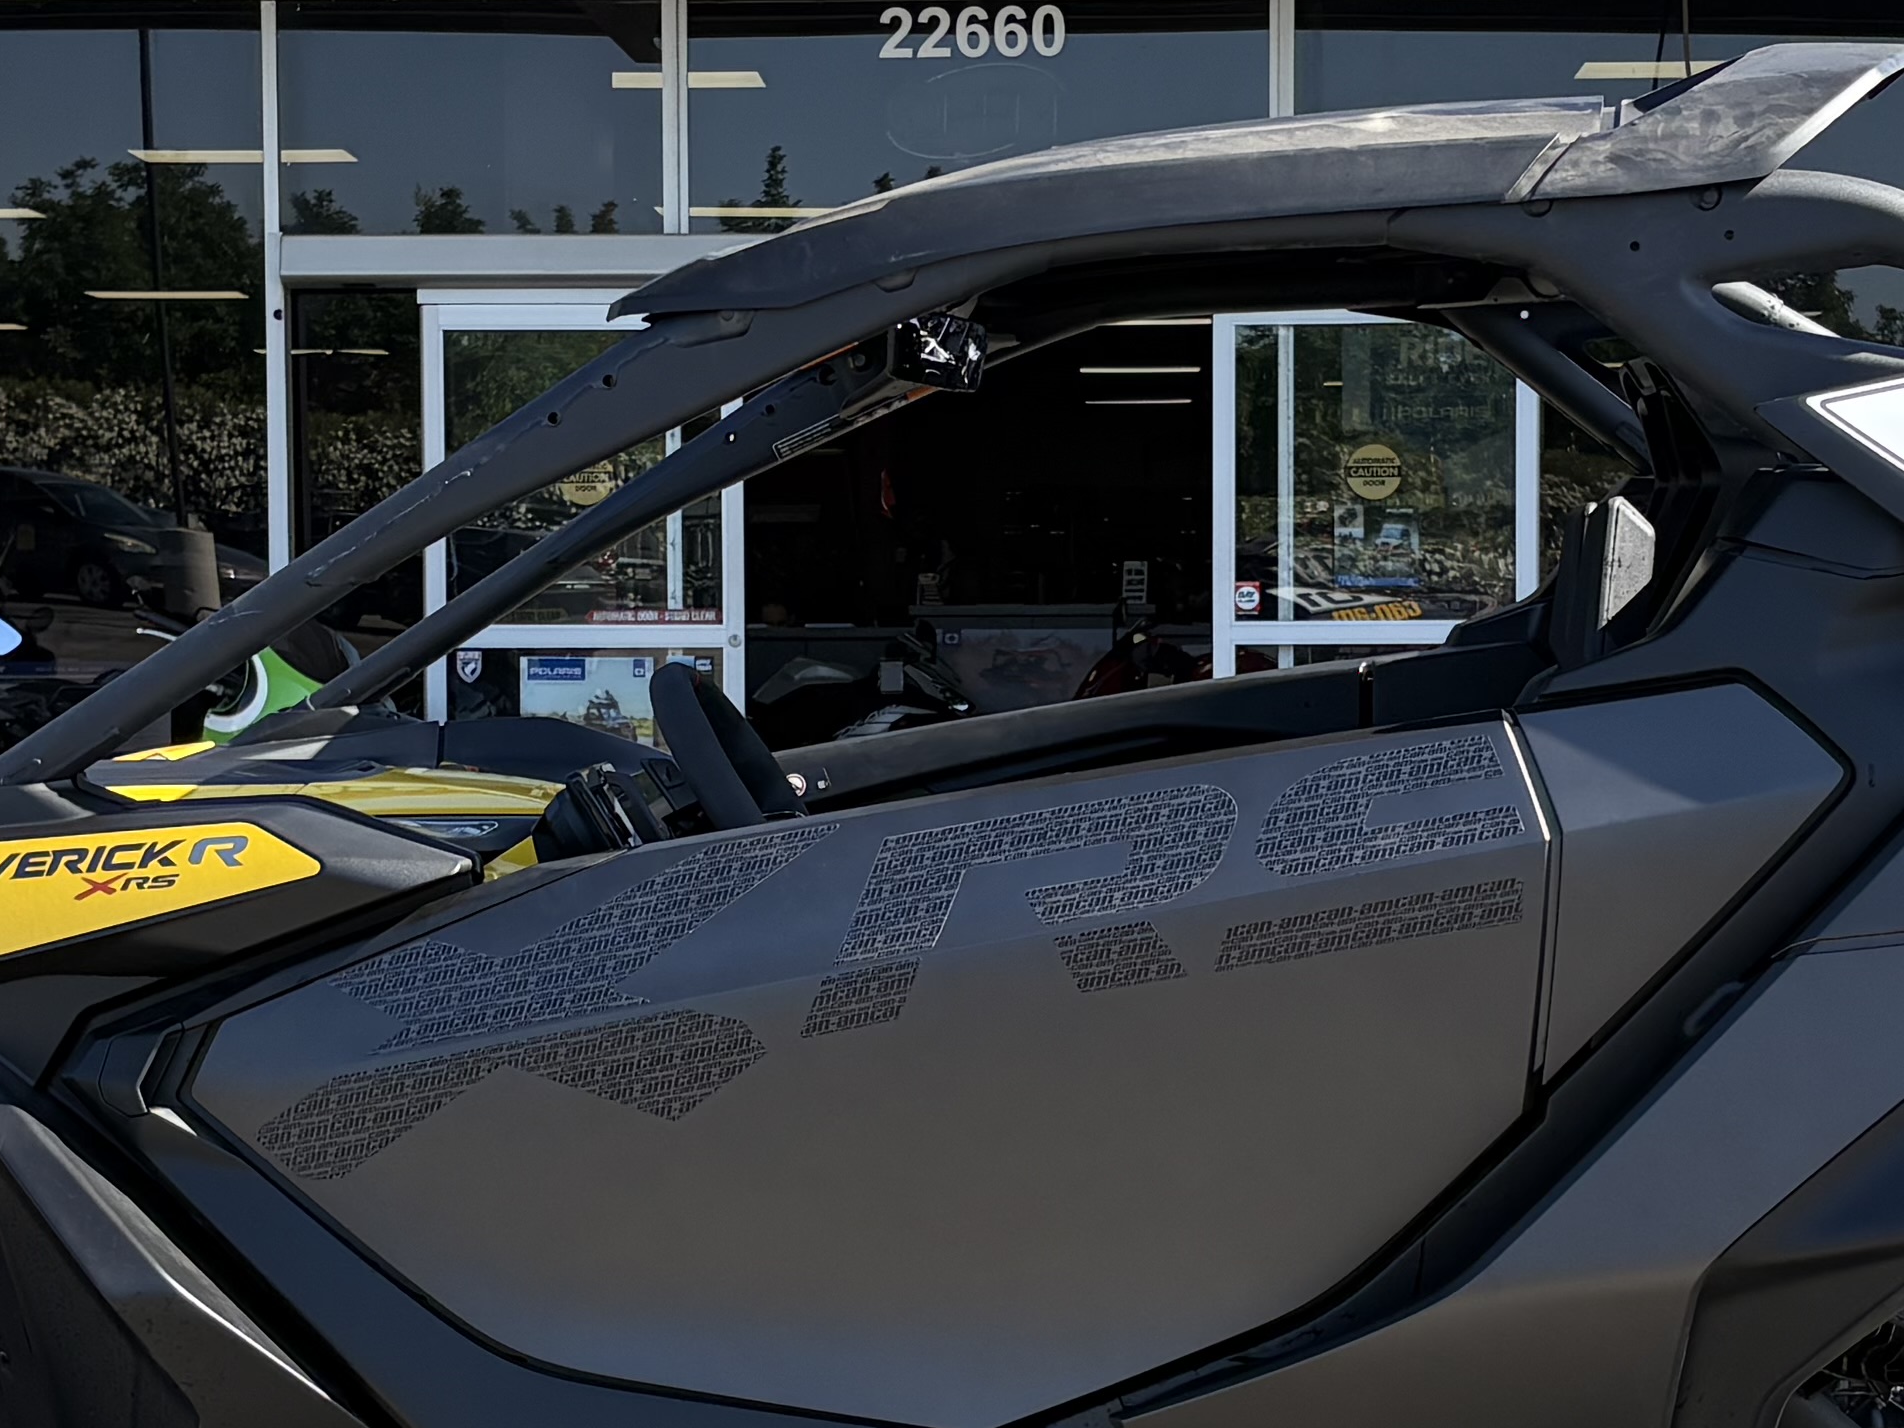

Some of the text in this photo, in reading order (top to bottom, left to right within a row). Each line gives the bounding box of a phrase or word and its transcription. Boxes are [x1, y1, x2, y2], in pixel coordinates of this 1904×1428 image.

[879, 4, 1065, 58] 22660
[1350, 467, 1399, 477] CAUTION
[188, 835, 249, 866] R
[74, 873, 180, 901] XRS
